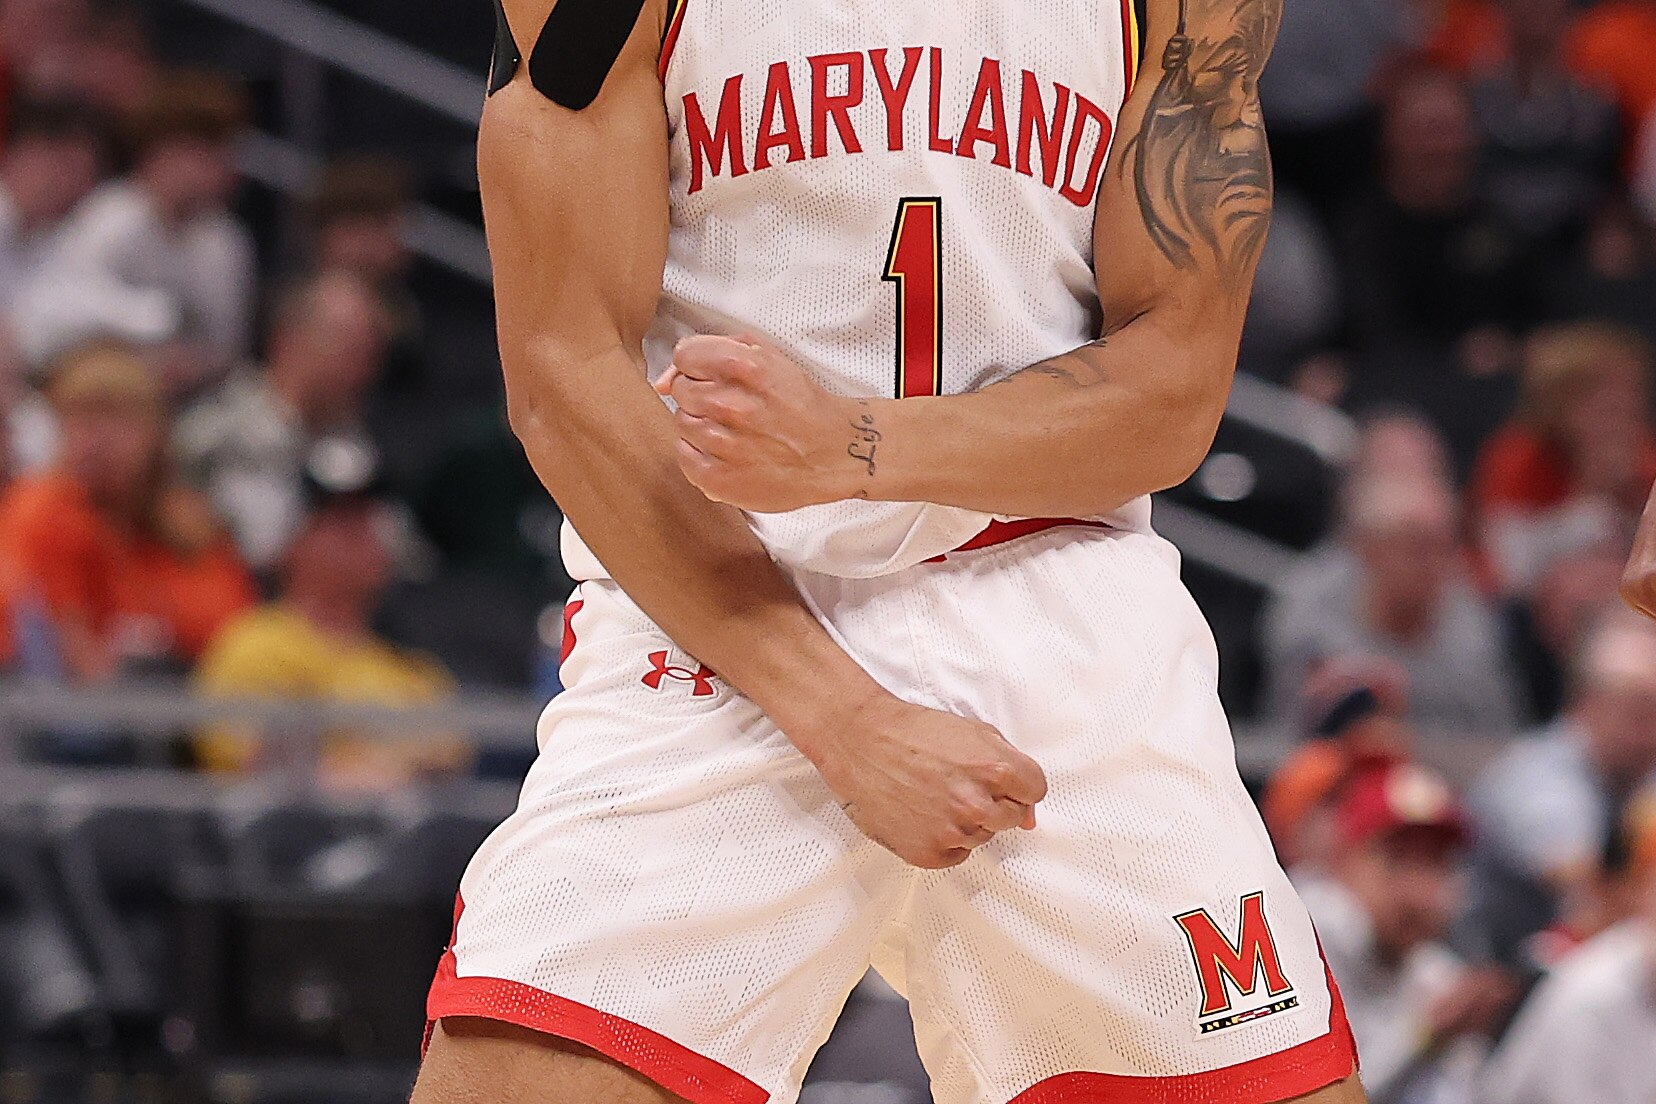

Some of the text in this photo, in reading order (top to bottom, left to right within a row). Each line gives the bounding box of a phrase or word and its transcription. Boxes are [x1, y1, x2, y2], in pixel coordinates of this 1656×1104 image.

[682, 46, 1113, 208] MARYLAND
[881, 196, 943, 399] 1
[1171, 889, 1294, 1018] M
